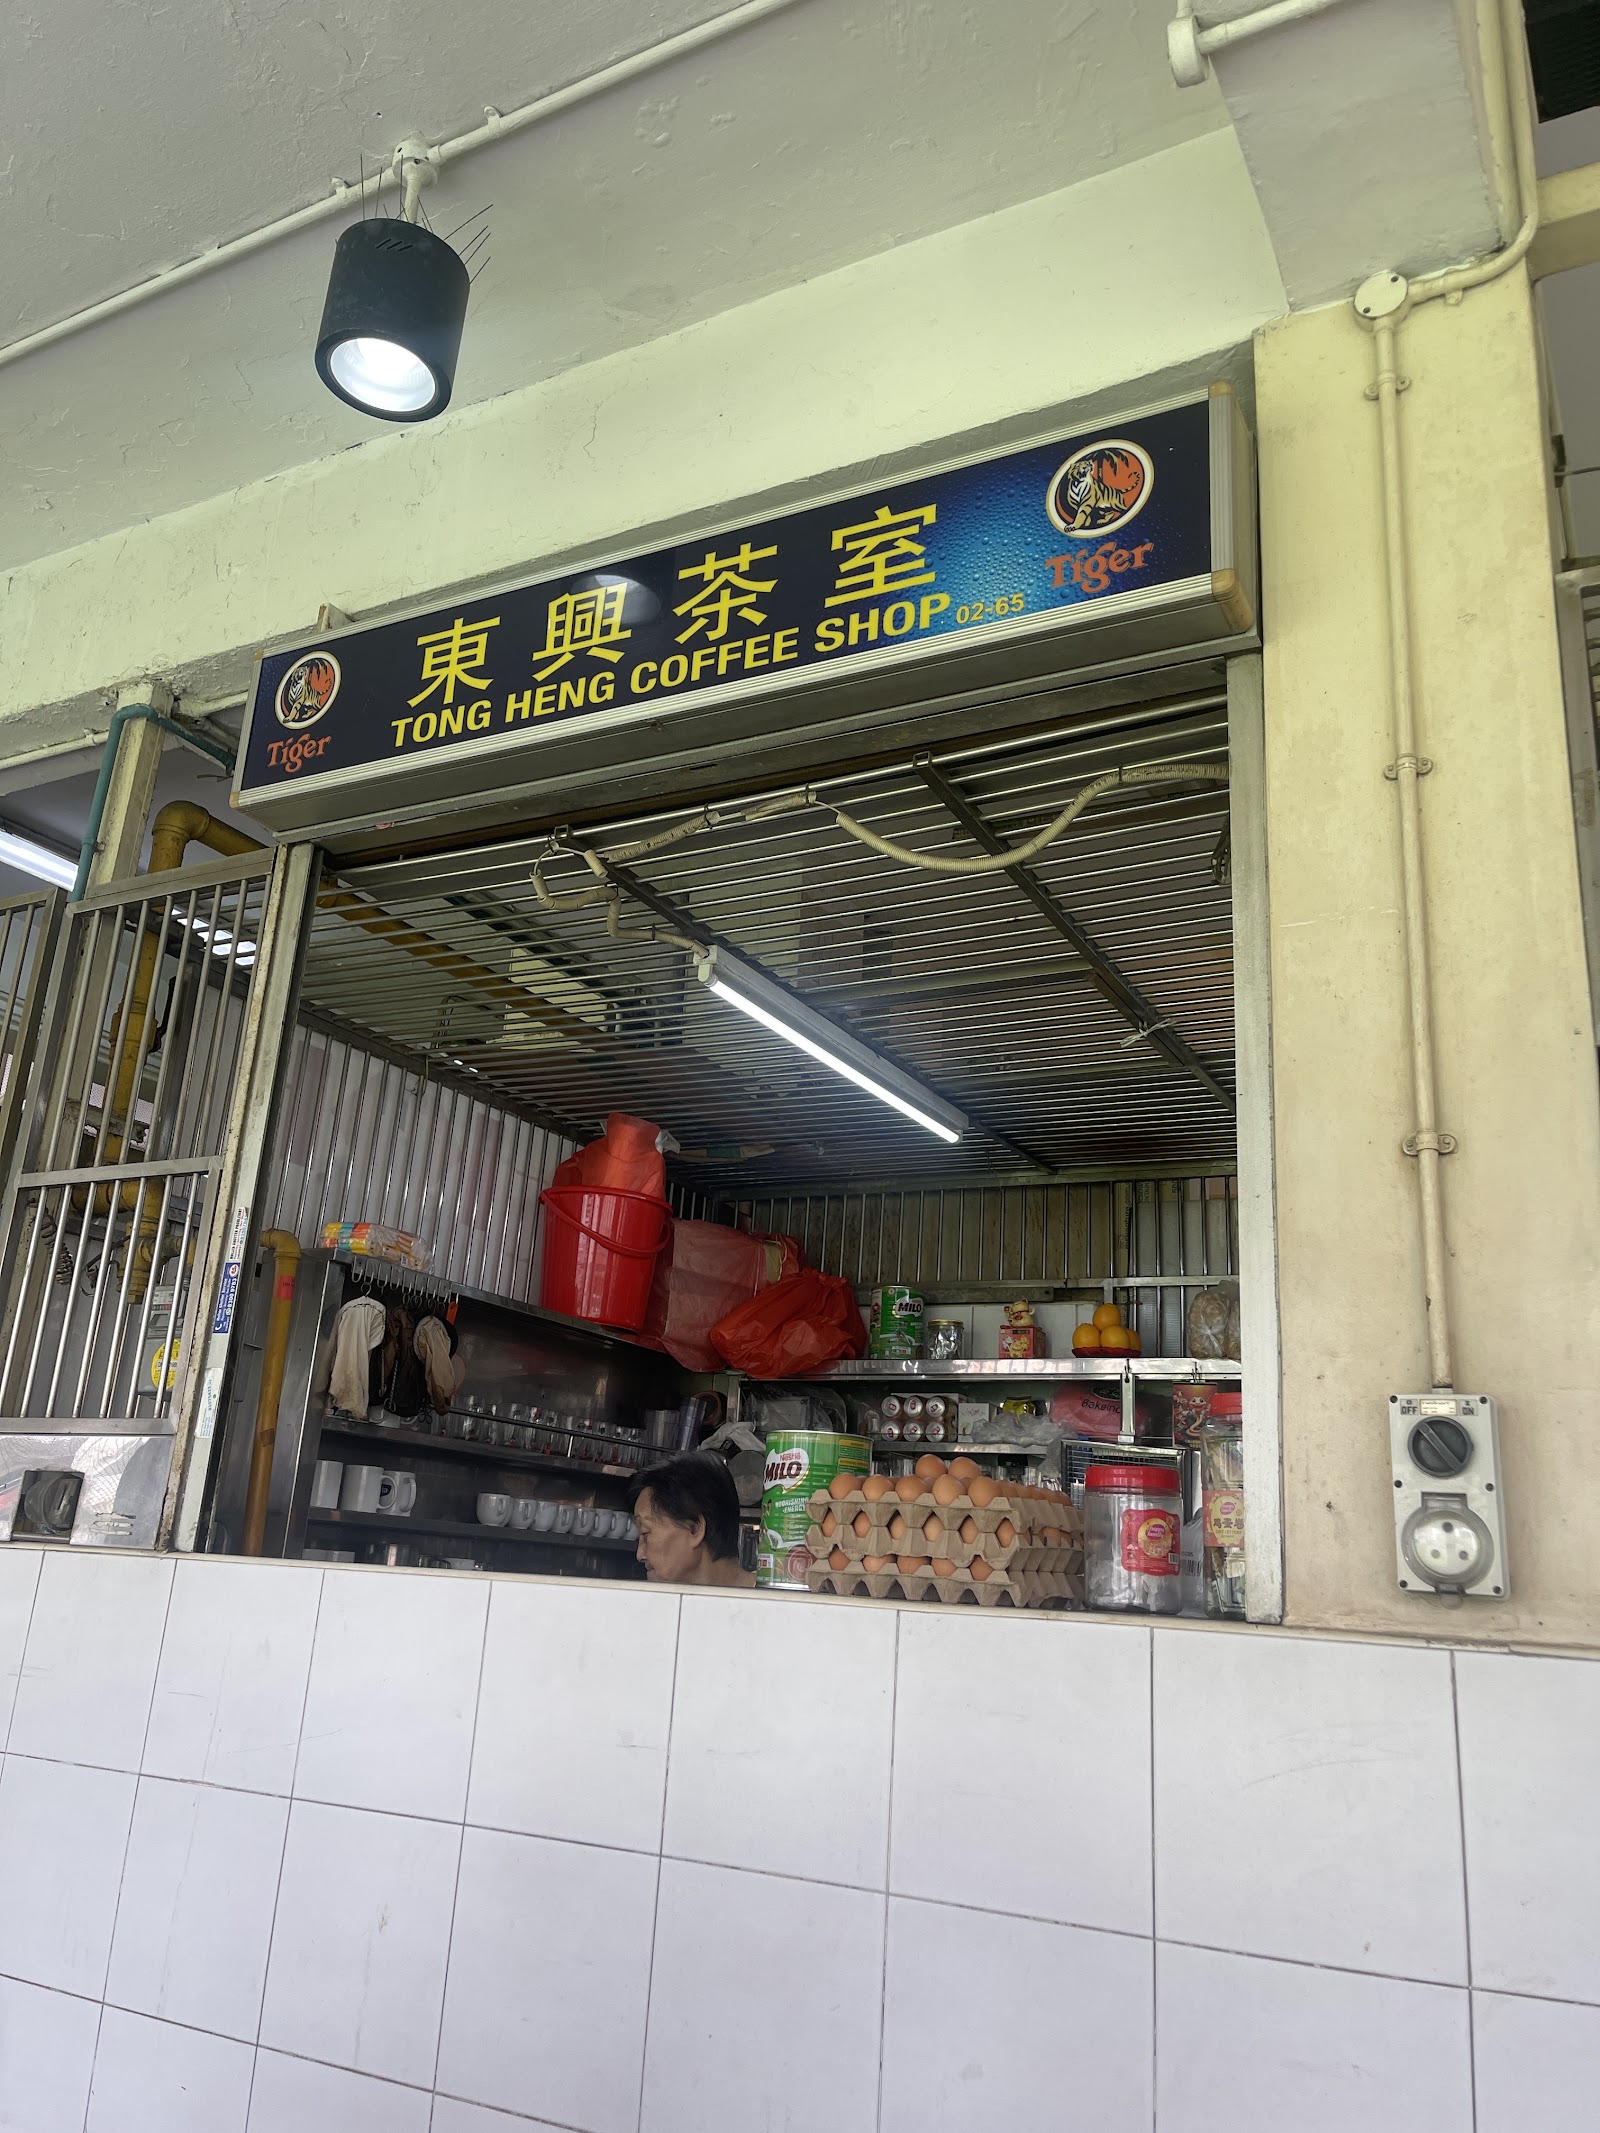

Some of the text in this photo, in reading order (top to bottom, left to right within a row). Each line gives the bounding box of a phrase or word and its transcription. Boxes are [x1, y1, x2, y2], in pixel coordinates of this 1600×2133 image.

[1044, 541, 1155, 593] Tiger
[407, 503, 938, 708] 東興茶室
[391, 592, 1025, 747] TONG HENG COFFEE SHOP 02-65
[267, 733, 331, 773] Tiger
[897, 1302, 922, 1313] MILO
[1401, 1406, 1418, 1415] OFF
[1461, 1406, 1474, 1415] ON
[764, 1461, 802, 1482] MILO
